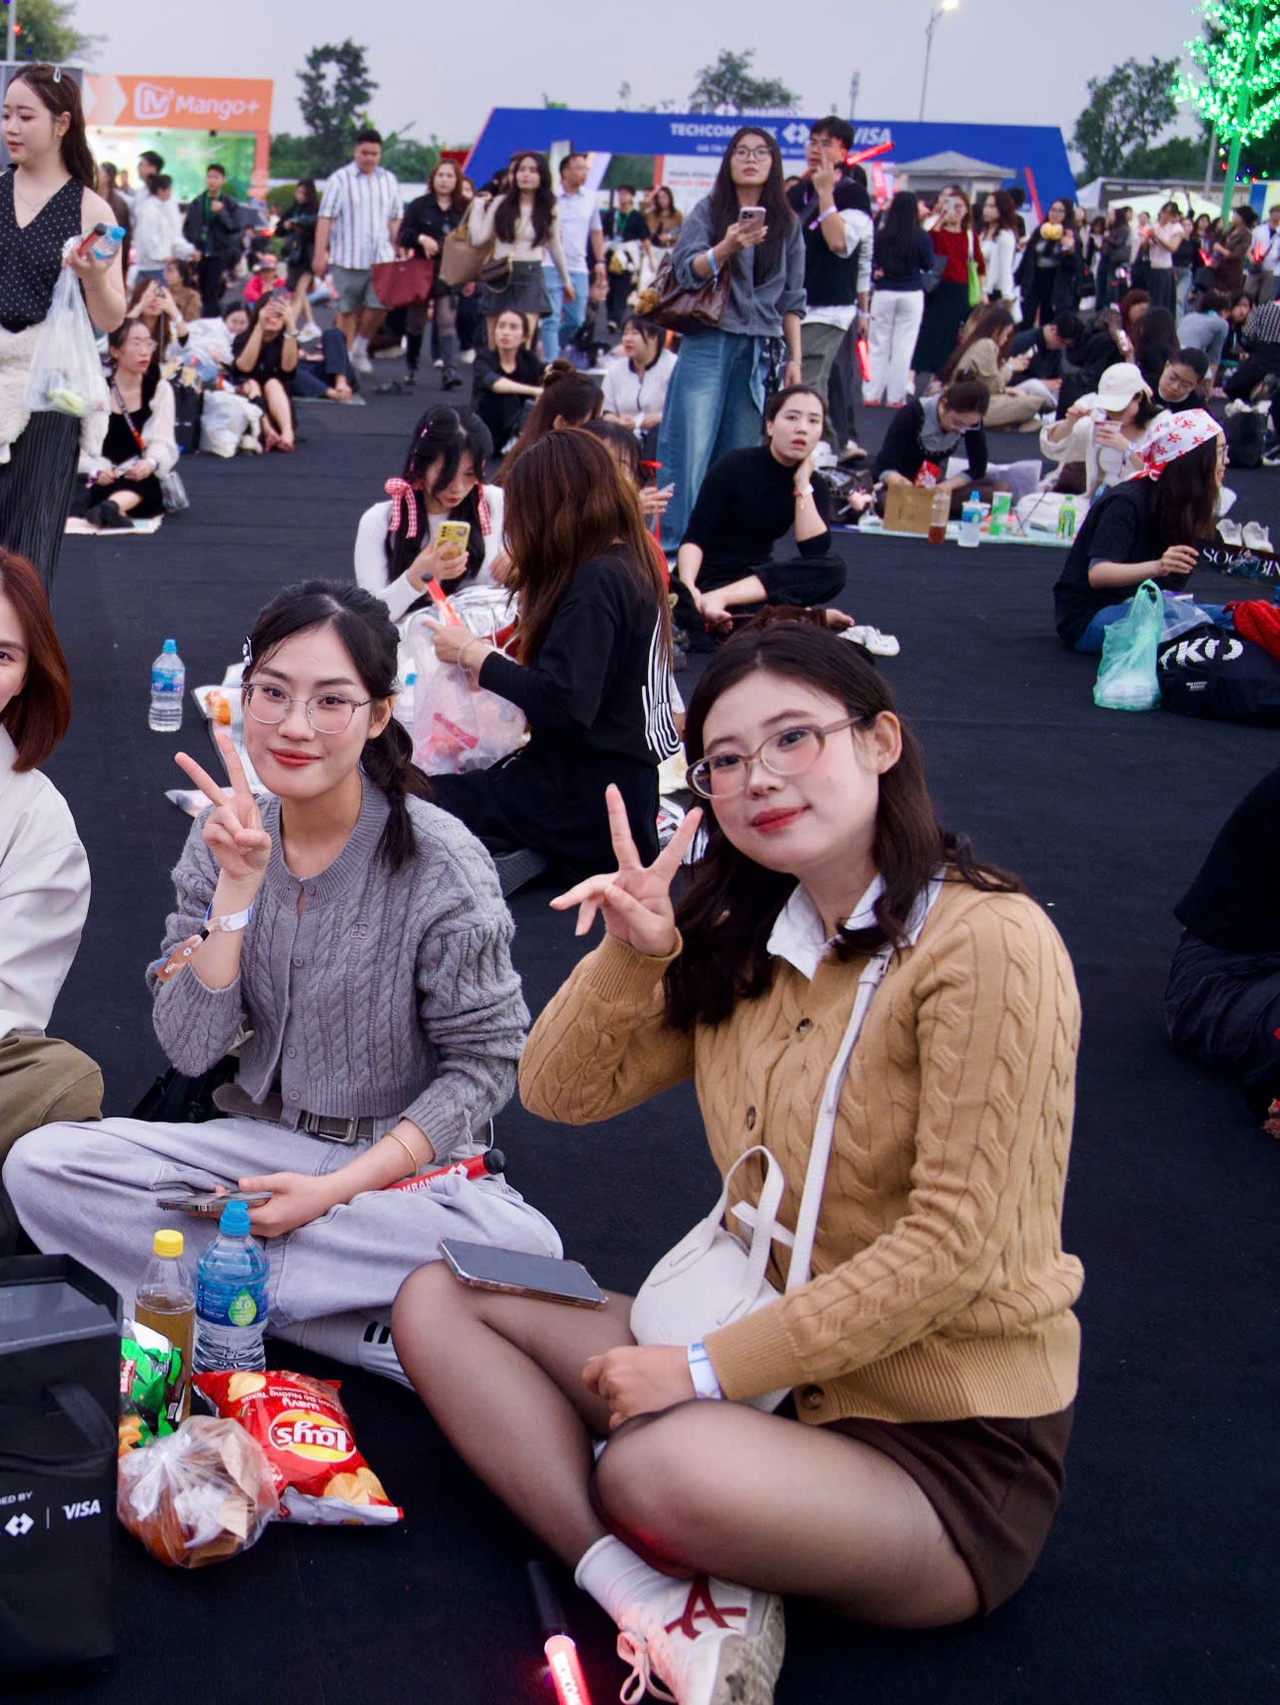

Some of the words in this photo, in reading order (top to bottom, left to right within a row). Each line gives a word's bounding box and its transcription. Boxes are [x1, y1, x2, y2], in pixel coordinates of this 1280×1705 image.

[175, 95, 259, 120] Mango+
[276, 1420, 347, 1452] Lay's
[17, 1491, 33, 1501] BY
[63, 1499, 101, 1520] VISA
